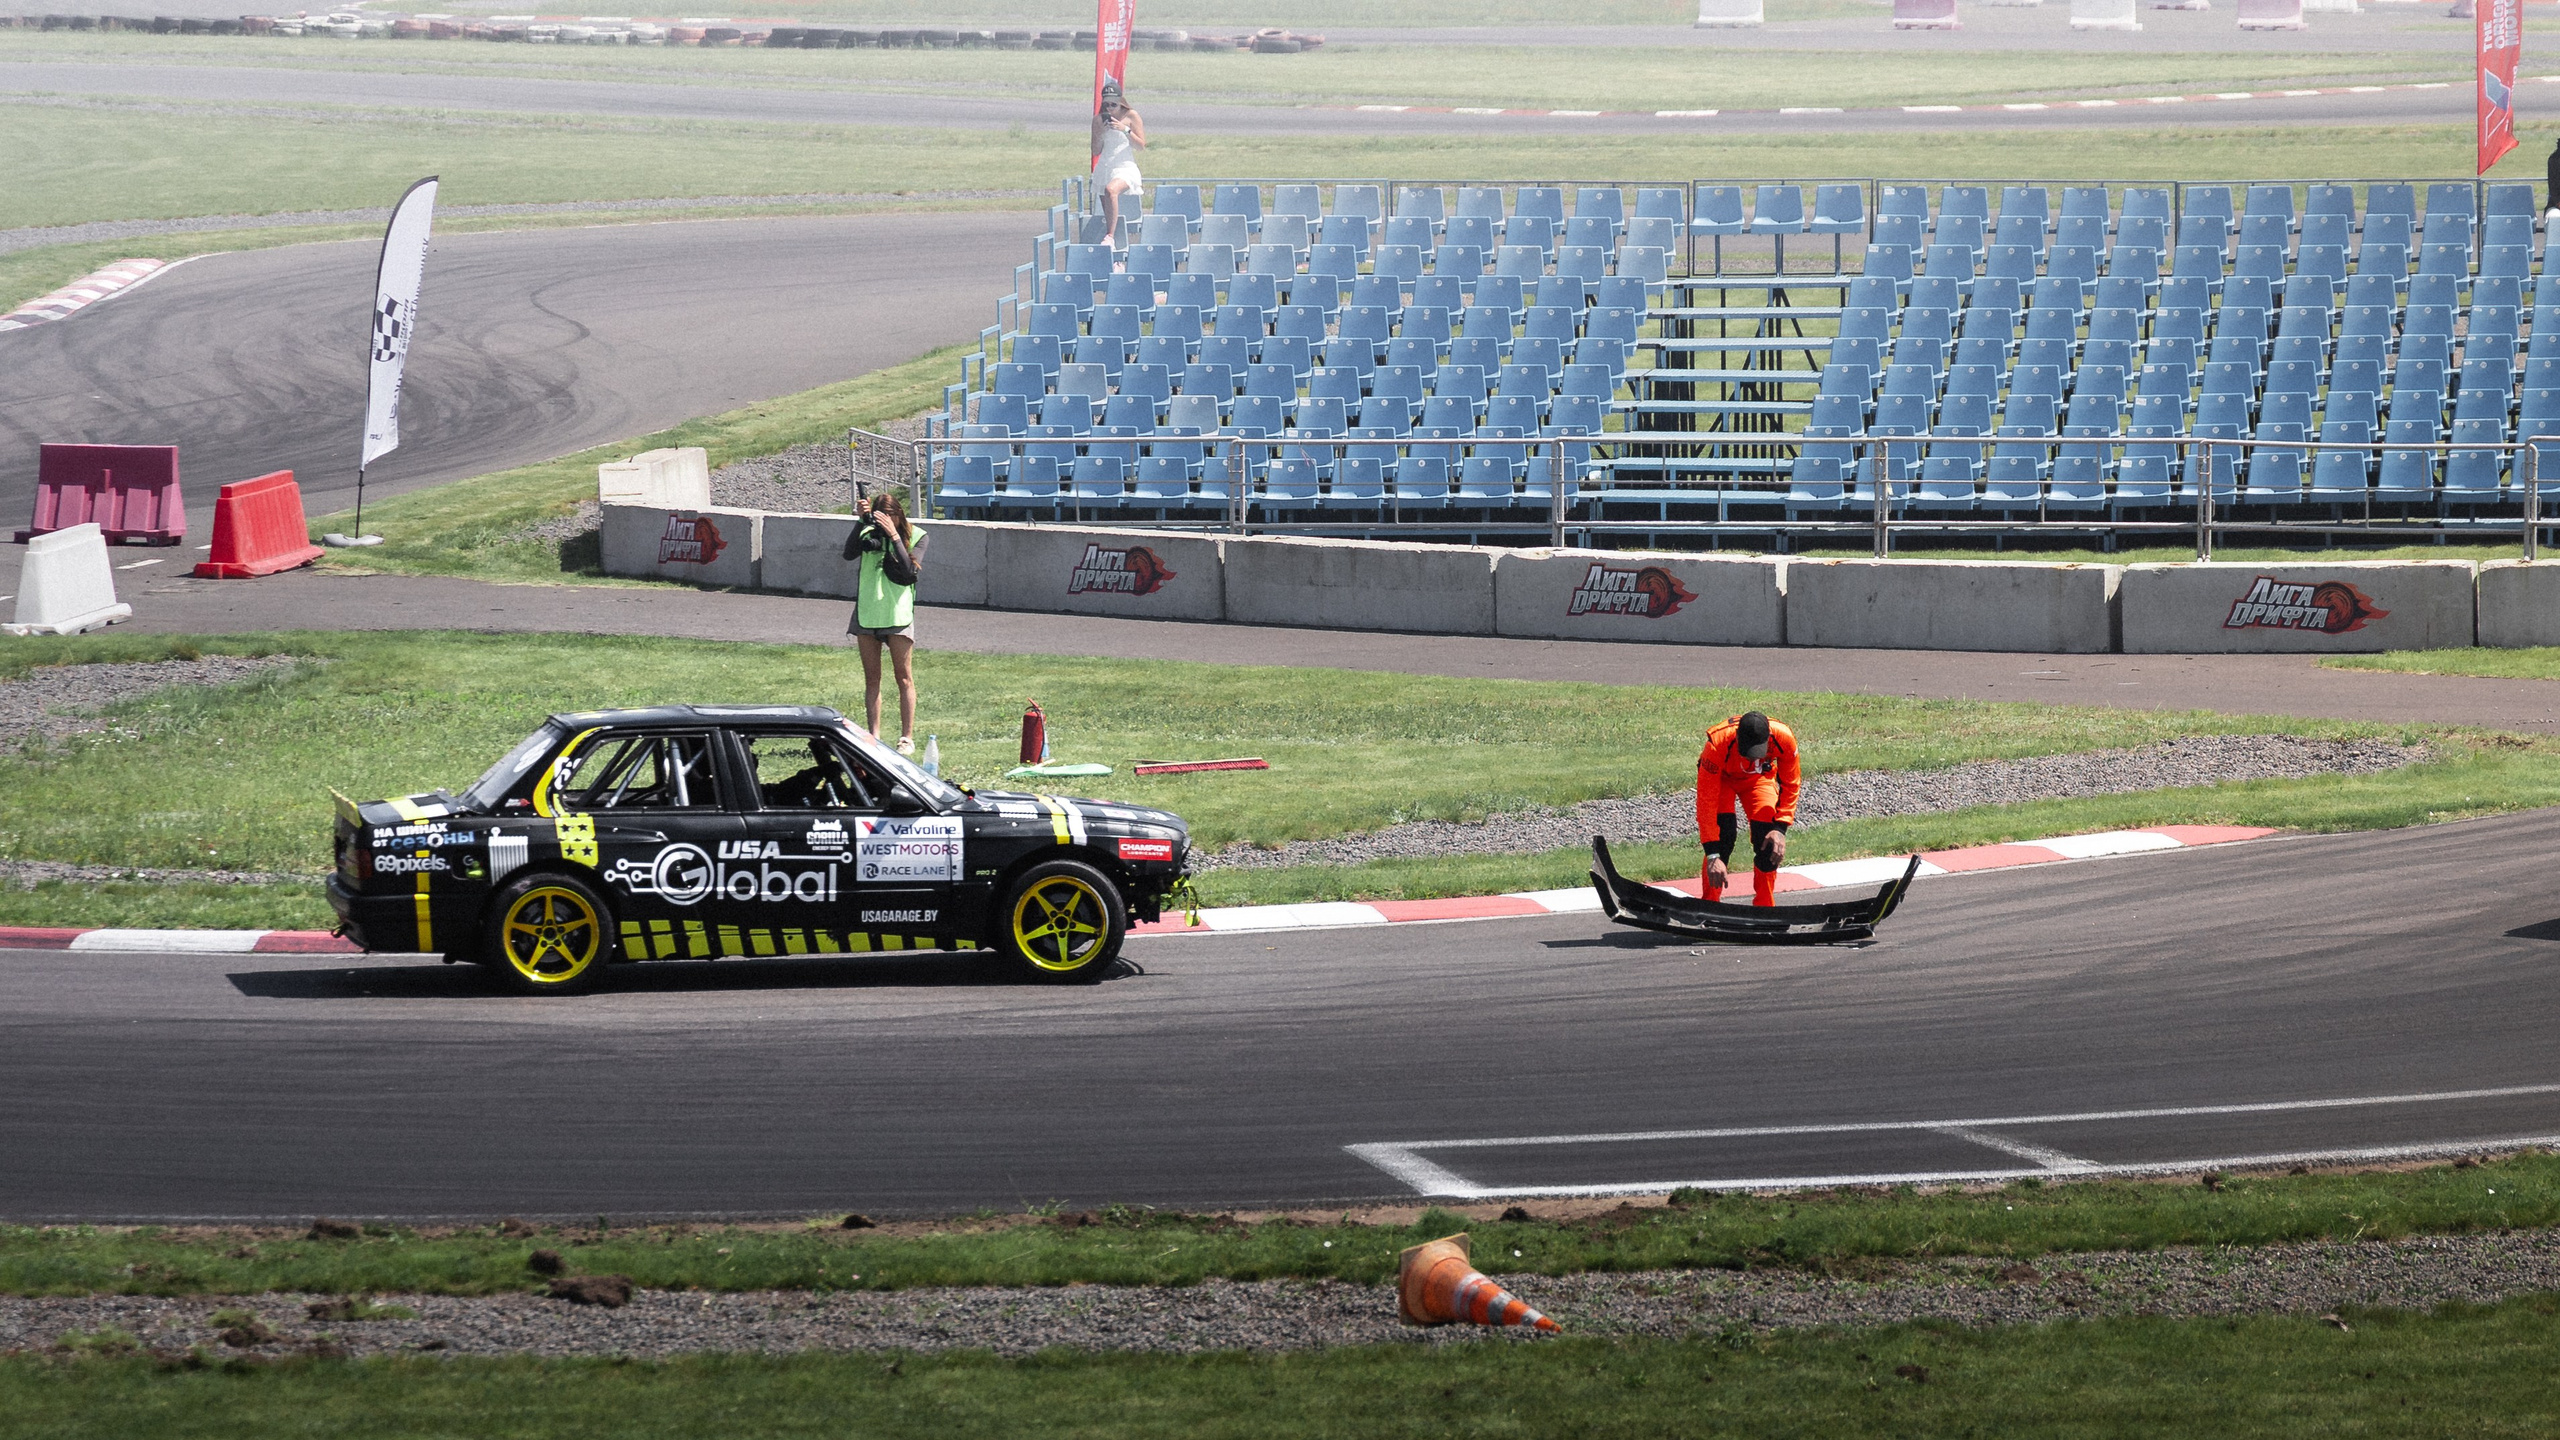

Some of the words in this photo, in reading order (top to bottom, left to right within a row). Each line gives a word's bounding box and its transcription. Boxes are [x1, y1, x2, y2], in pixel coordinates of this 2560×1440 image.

[1104, 22, 1117, 54] THE
[373, 827, 394, 838] НА
[396, 822, 448, 836] ШИНАХ
[890, 823, 957, 835] Valvoline
[806, 831, 849, 845] GORILLA
[717, 840, 781, 859] USA
[861, 844, 959, 855] WESTMOTORS
[1120, 843, 1171, 853] CHAMPION
[654, 846, 837, 904] Global
[881, 866, 911, 875] RACE
[914, 866, 945, 875] LANE
[861, 910, 938, 923] USAGARAGE.BY
